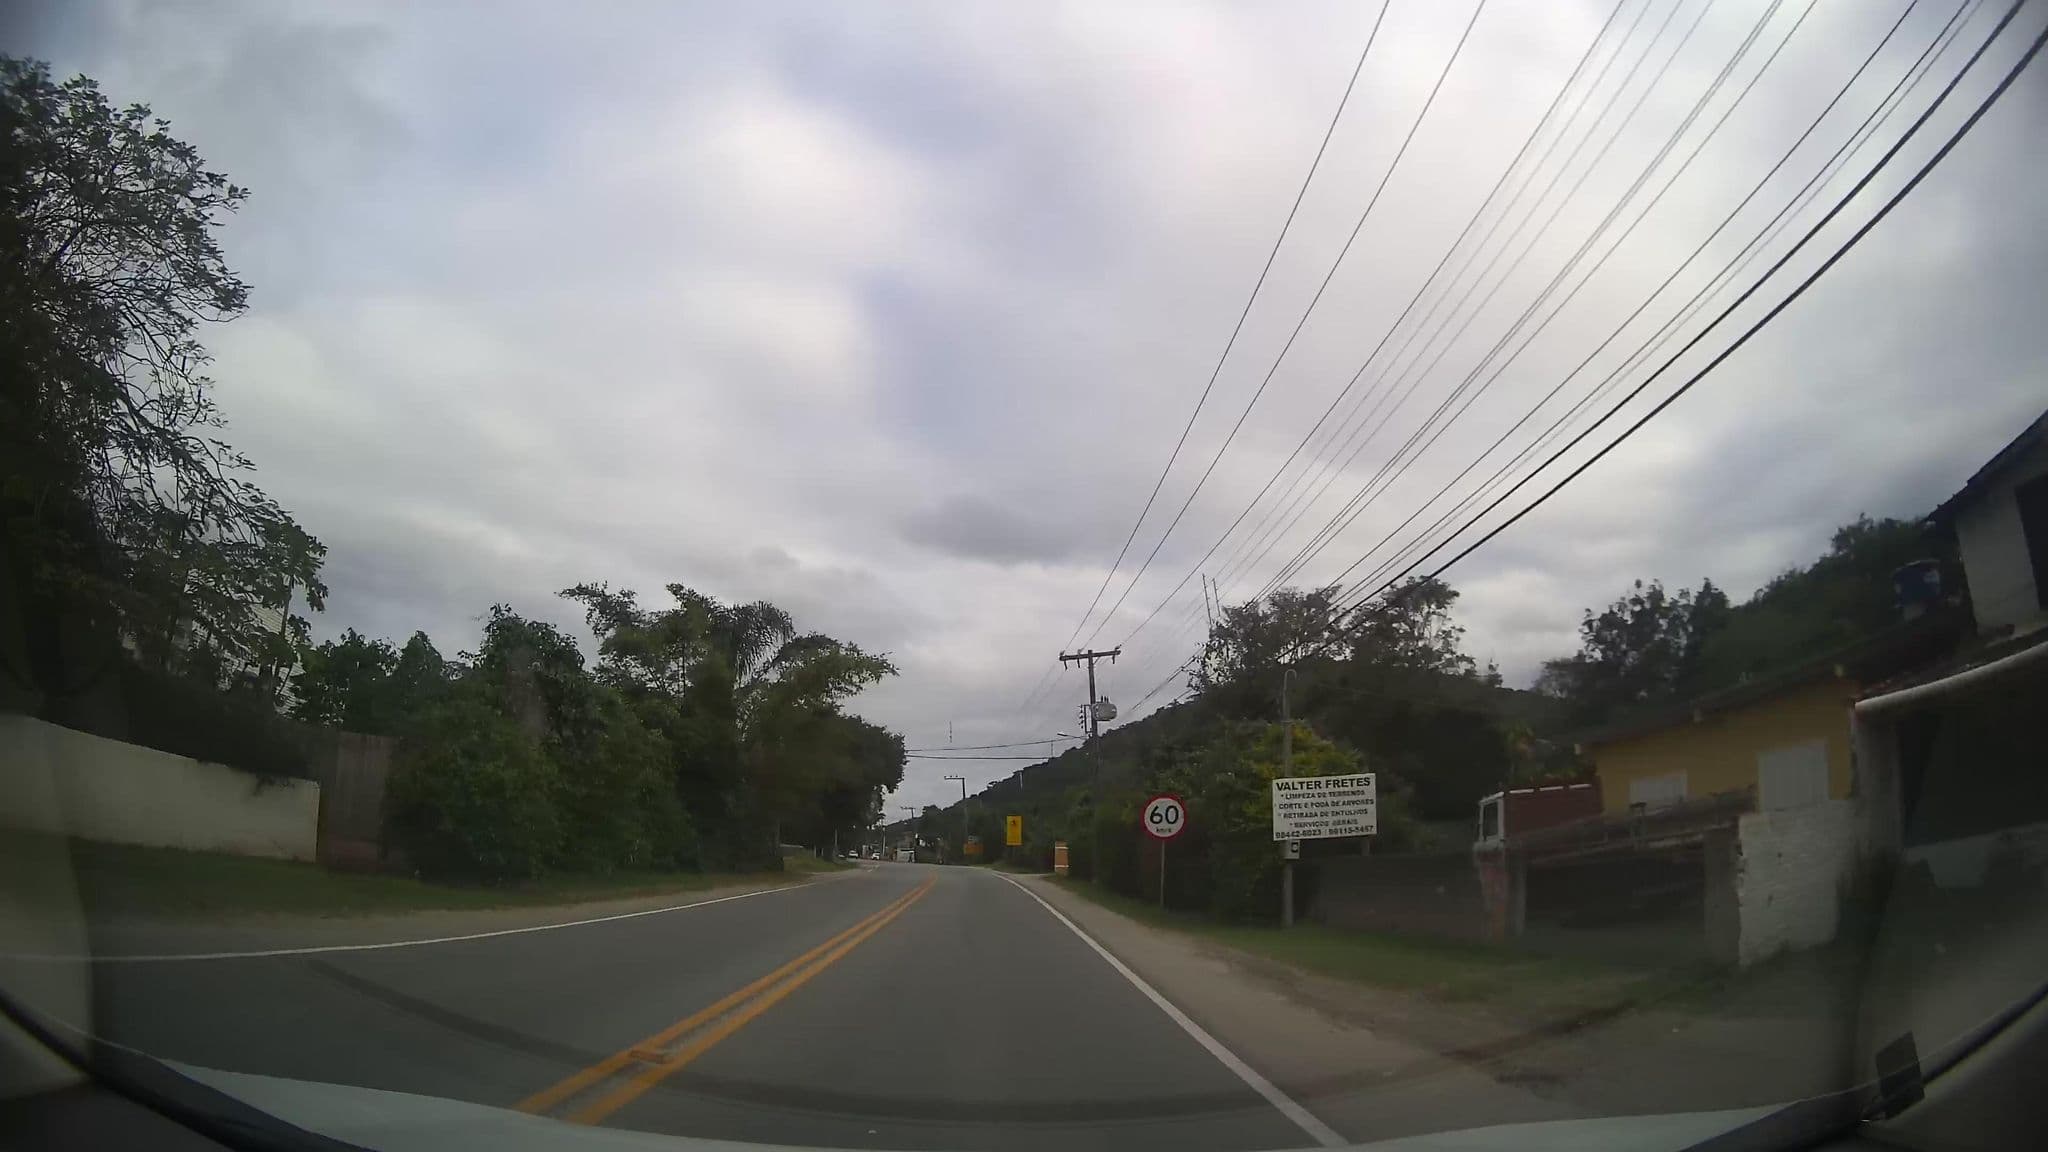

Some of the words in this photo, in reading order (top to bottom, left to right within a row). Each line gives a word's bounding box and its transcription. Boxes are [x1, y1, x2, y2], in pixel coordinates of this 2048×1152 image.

[1276, 780, 1322, 791] VALTER
[1325, 777, 1371, 789] FRETES
[1150, 805, 1179, 824] 60
